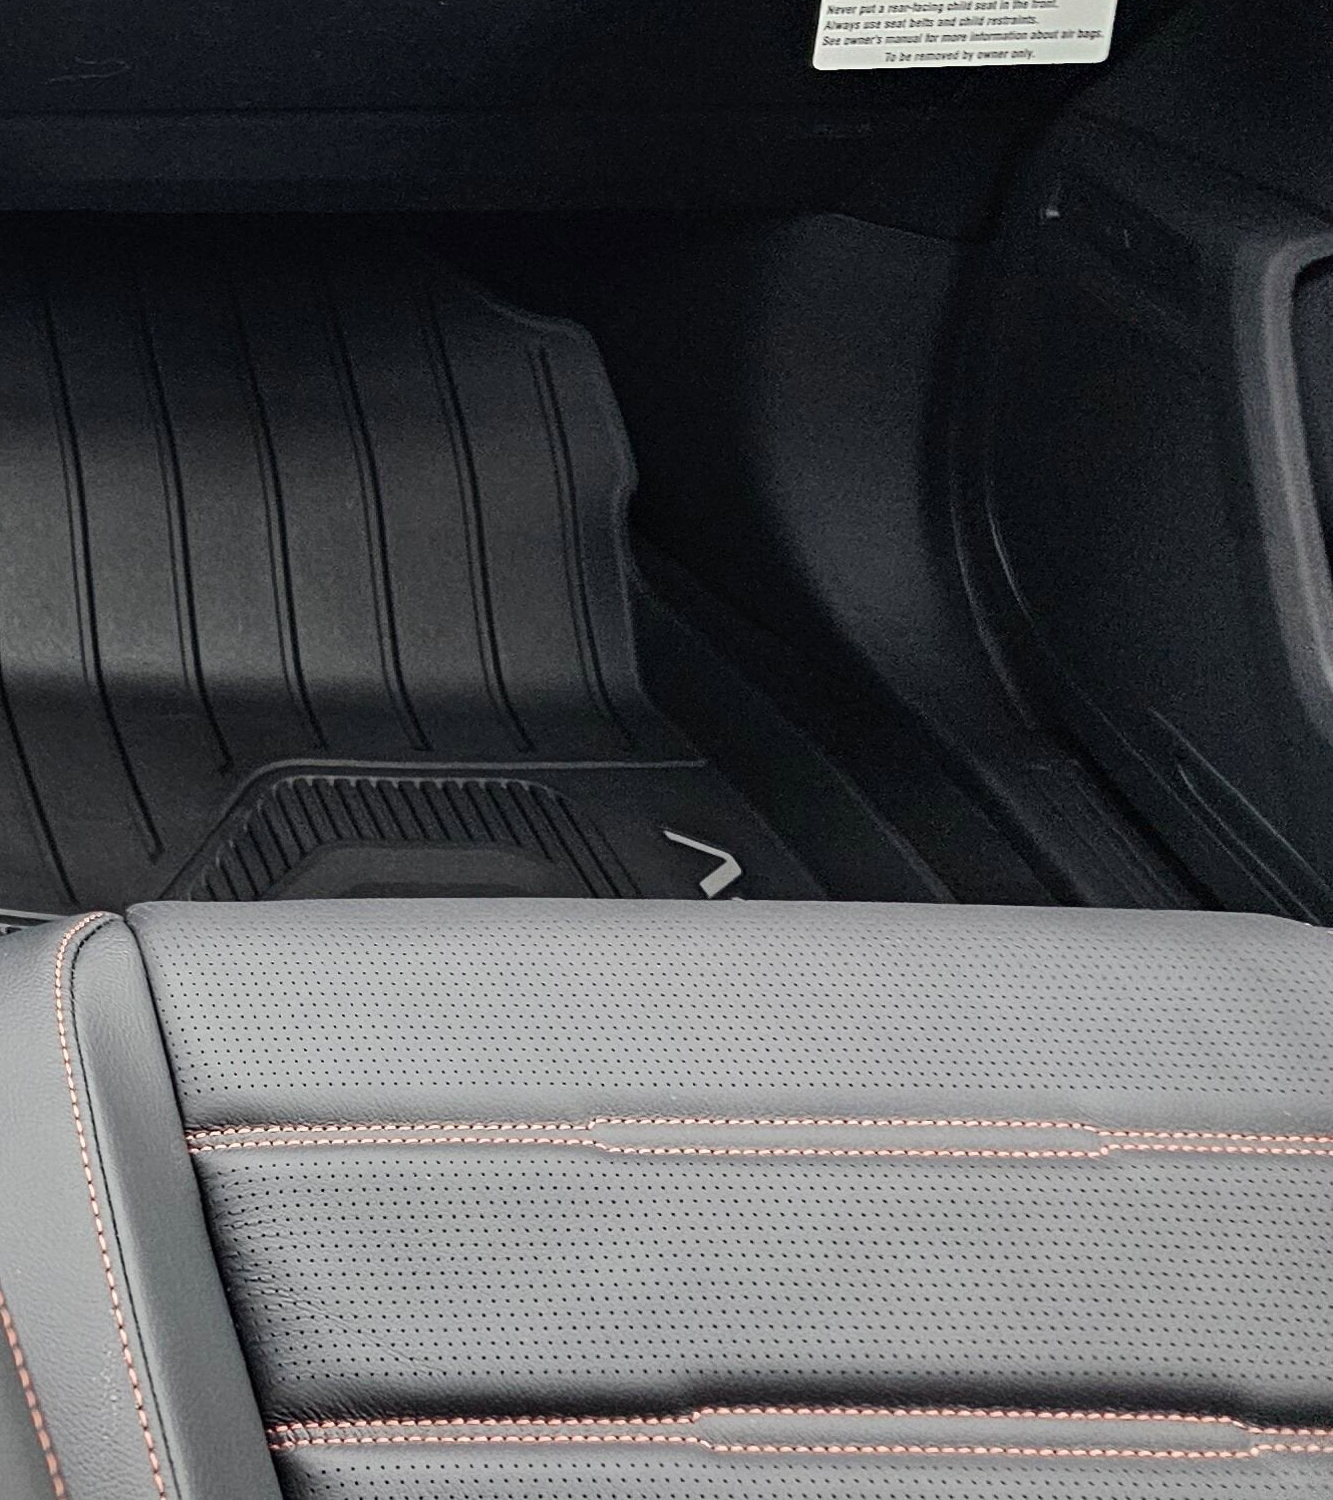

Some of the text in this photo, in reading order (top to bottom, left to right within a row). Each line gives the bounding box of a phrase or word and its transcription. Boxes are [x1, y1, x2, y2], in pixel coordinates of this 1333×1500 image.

[826, 5, 857, 16] Never
[859, 4, 877, 16] put
[878, 5, 885, 14] a
[887, 2, 944, 15] rear-facing
[946, 1, 973, 12] child
[975, 0, 997, 11] seat
[999, 0, 1010, 10] in
[1012, 0, 1029, 9] the
[823, 15, 1040, 32] Always use seat belts and child restraints.
[822, 28, 1105, 46] See owner's manual for more information about air bags.
[884, 49, 1036, 62] To be removed by owner only.
